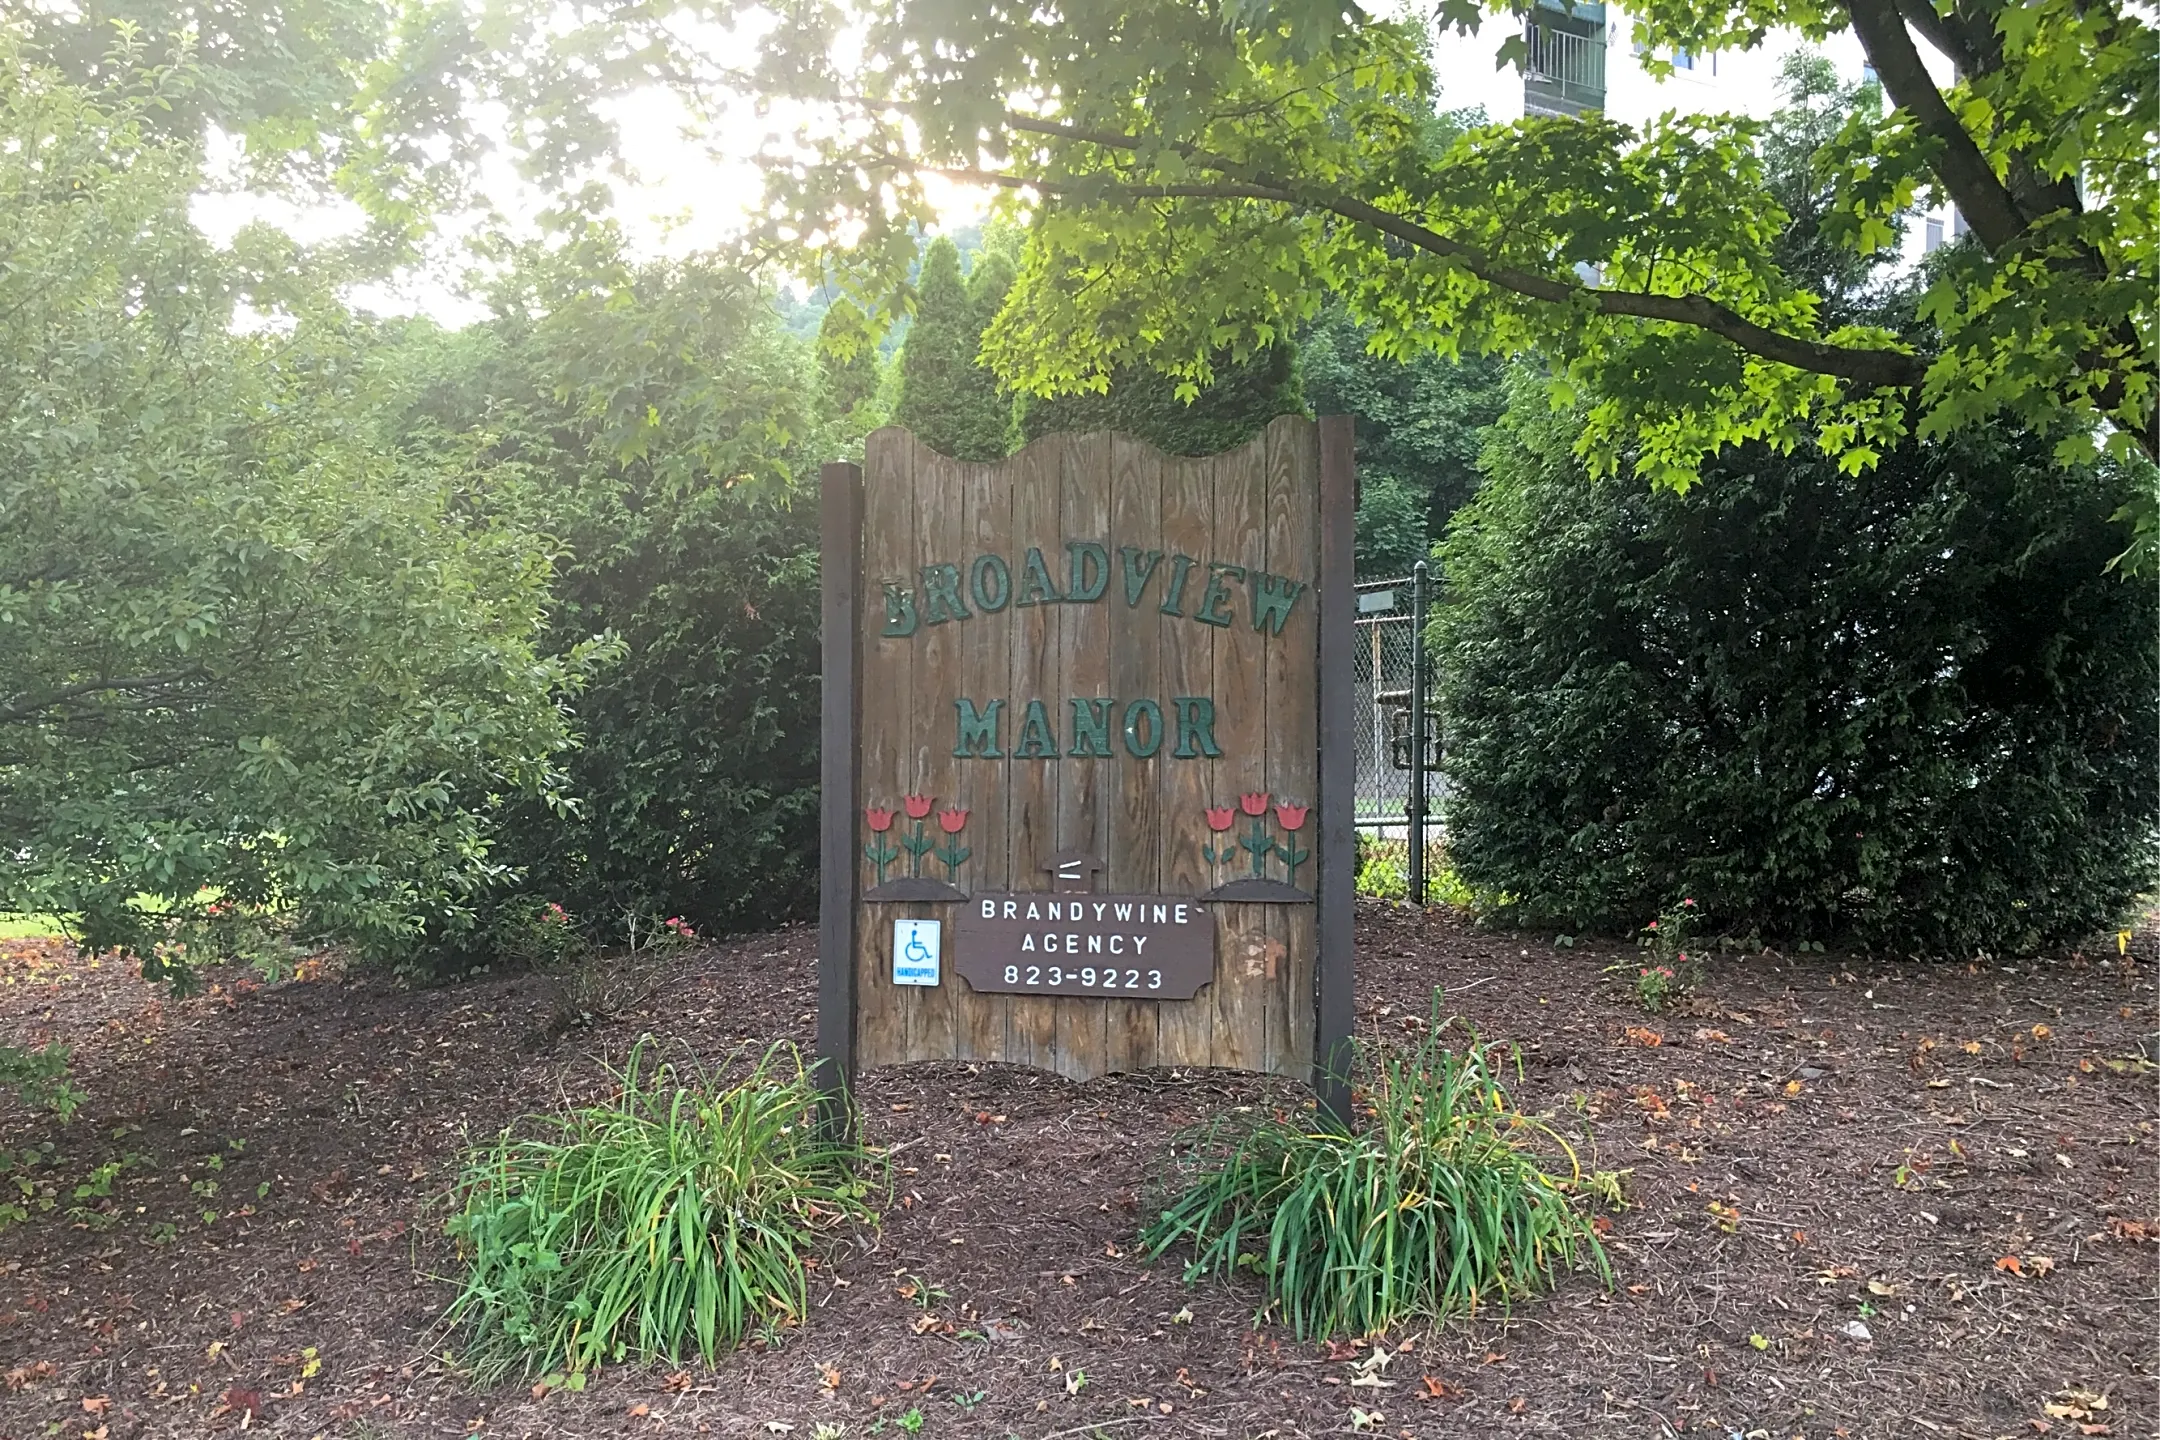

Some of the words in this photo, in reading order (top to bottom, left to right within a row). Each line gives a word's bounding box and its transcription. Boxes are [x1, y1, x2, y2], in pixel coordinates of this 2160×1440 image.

[880, 541, 1306, 637] BROADVIEW
[953, 697, 1222, 759] MANOR
[981, 899, 1189, 924] BRANDYWINE
[1021, 934, 1147, 955] AGENCY
[897, 967, 935, 978] HANDICAPPED
[1004, 966, 1163, 989] 823-9223
